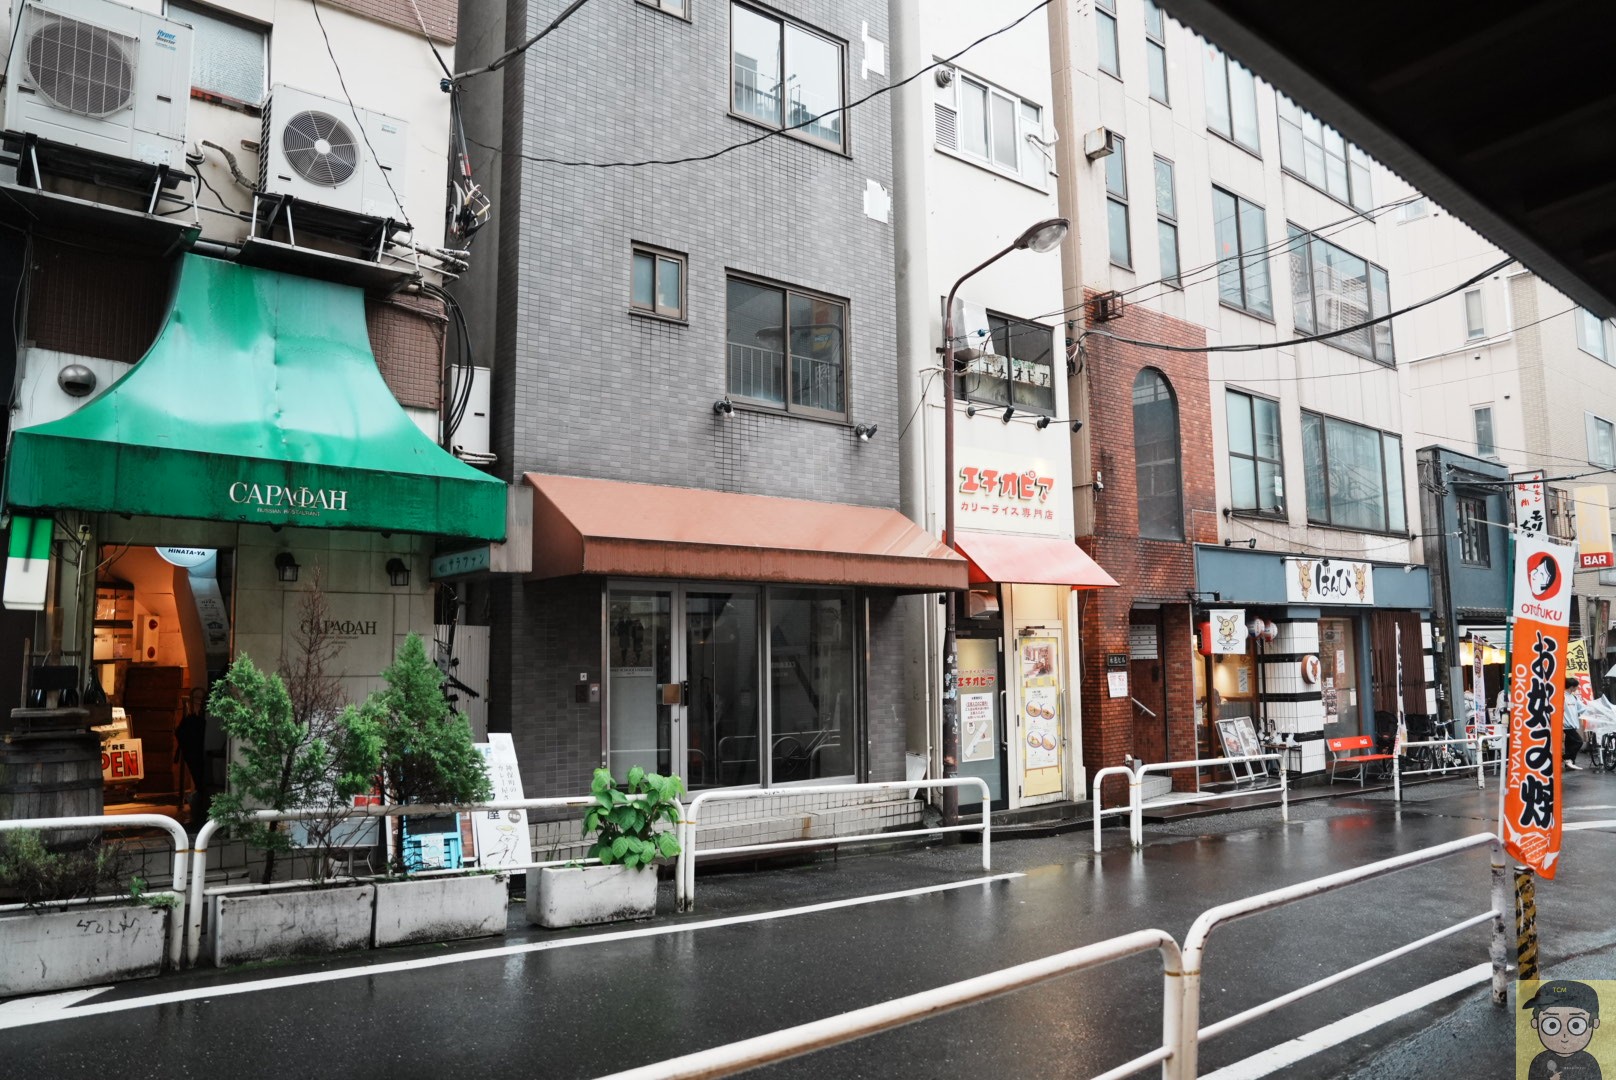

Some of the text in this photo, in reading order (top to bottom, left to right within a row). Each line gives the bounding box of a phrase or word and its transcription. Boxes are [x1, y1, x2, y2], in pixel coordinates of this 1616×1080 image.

[959, 466, 1054, 504] エチオピア
[961, 501, 1054, 520] カリーライス専門店
[168, 547, 206, 557] HINATA-YA
[1583, 555, 1607, 566] BAR
[1315, 563, 1352, 597] ばんび
[1509, 663, 1528, 789] OKONOMIYAKI
[101, 744, 126, 752] E'RE
[101, 751, 139, 778] PEN
